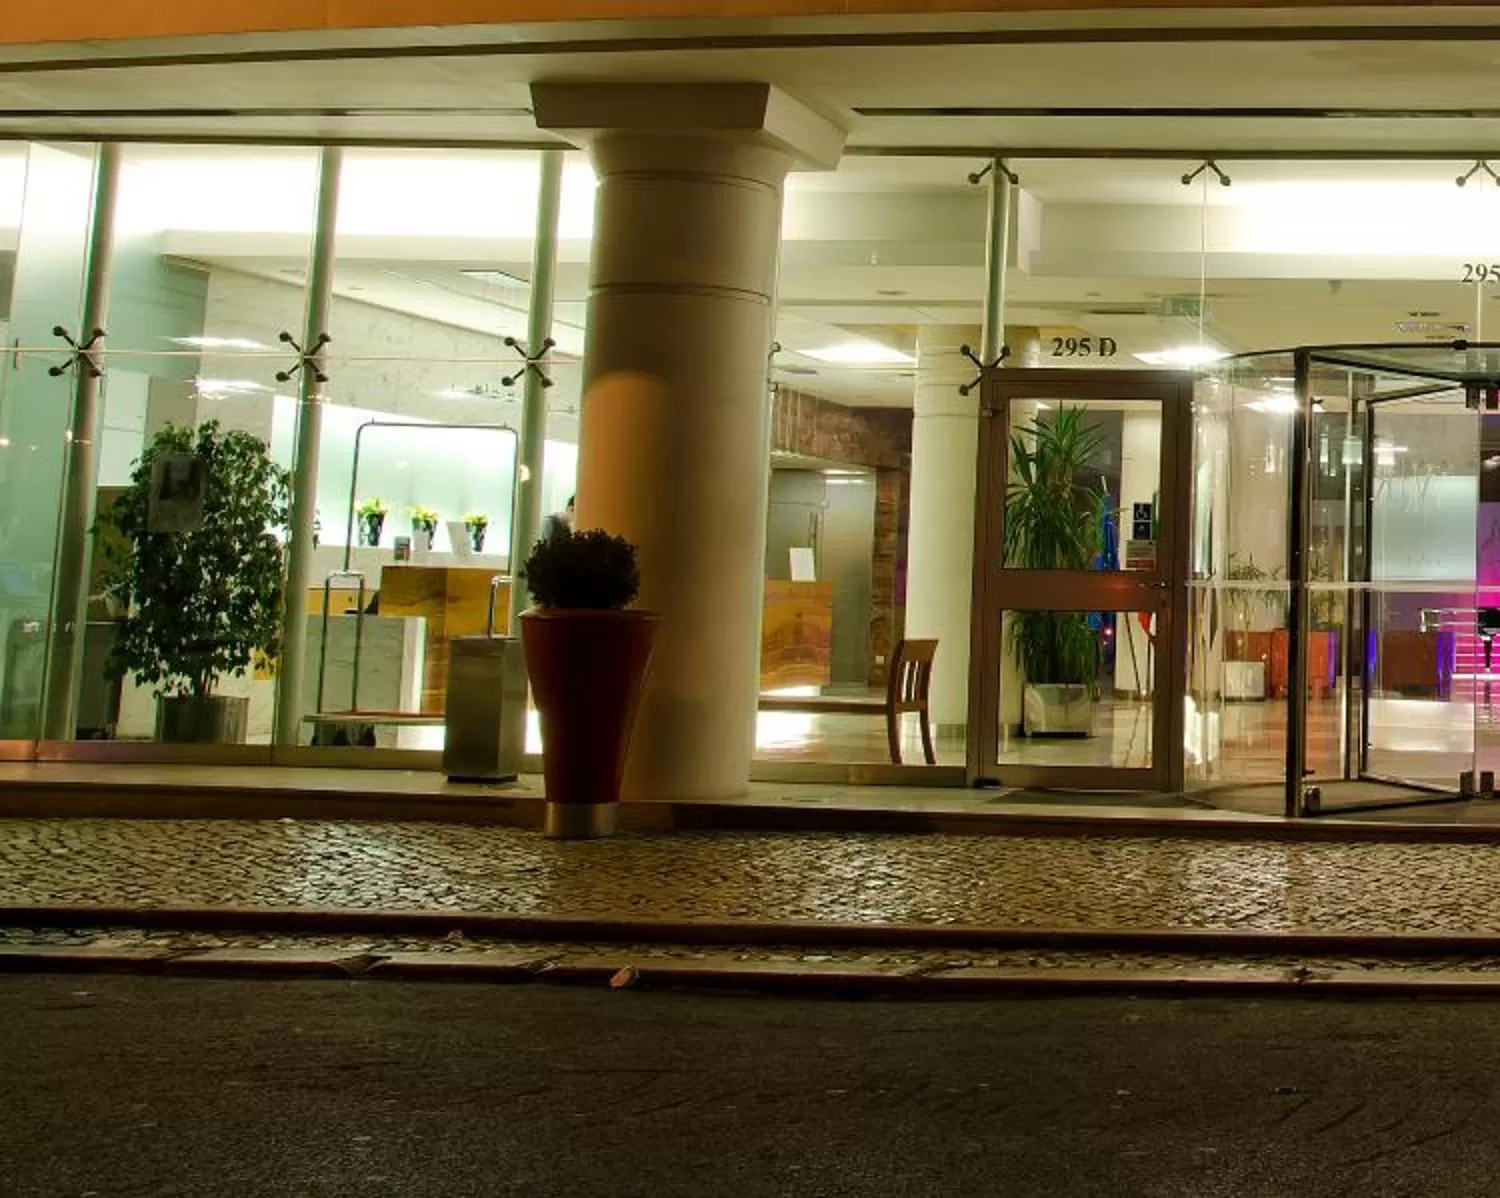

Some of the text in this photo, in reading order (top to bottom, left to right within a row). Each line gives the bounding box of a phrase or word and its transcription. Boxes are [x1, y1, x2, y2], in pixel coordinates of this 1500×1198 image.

[1461, 263, 1500, 283] 295
[1050, 337, 1117, 357] 295 D
